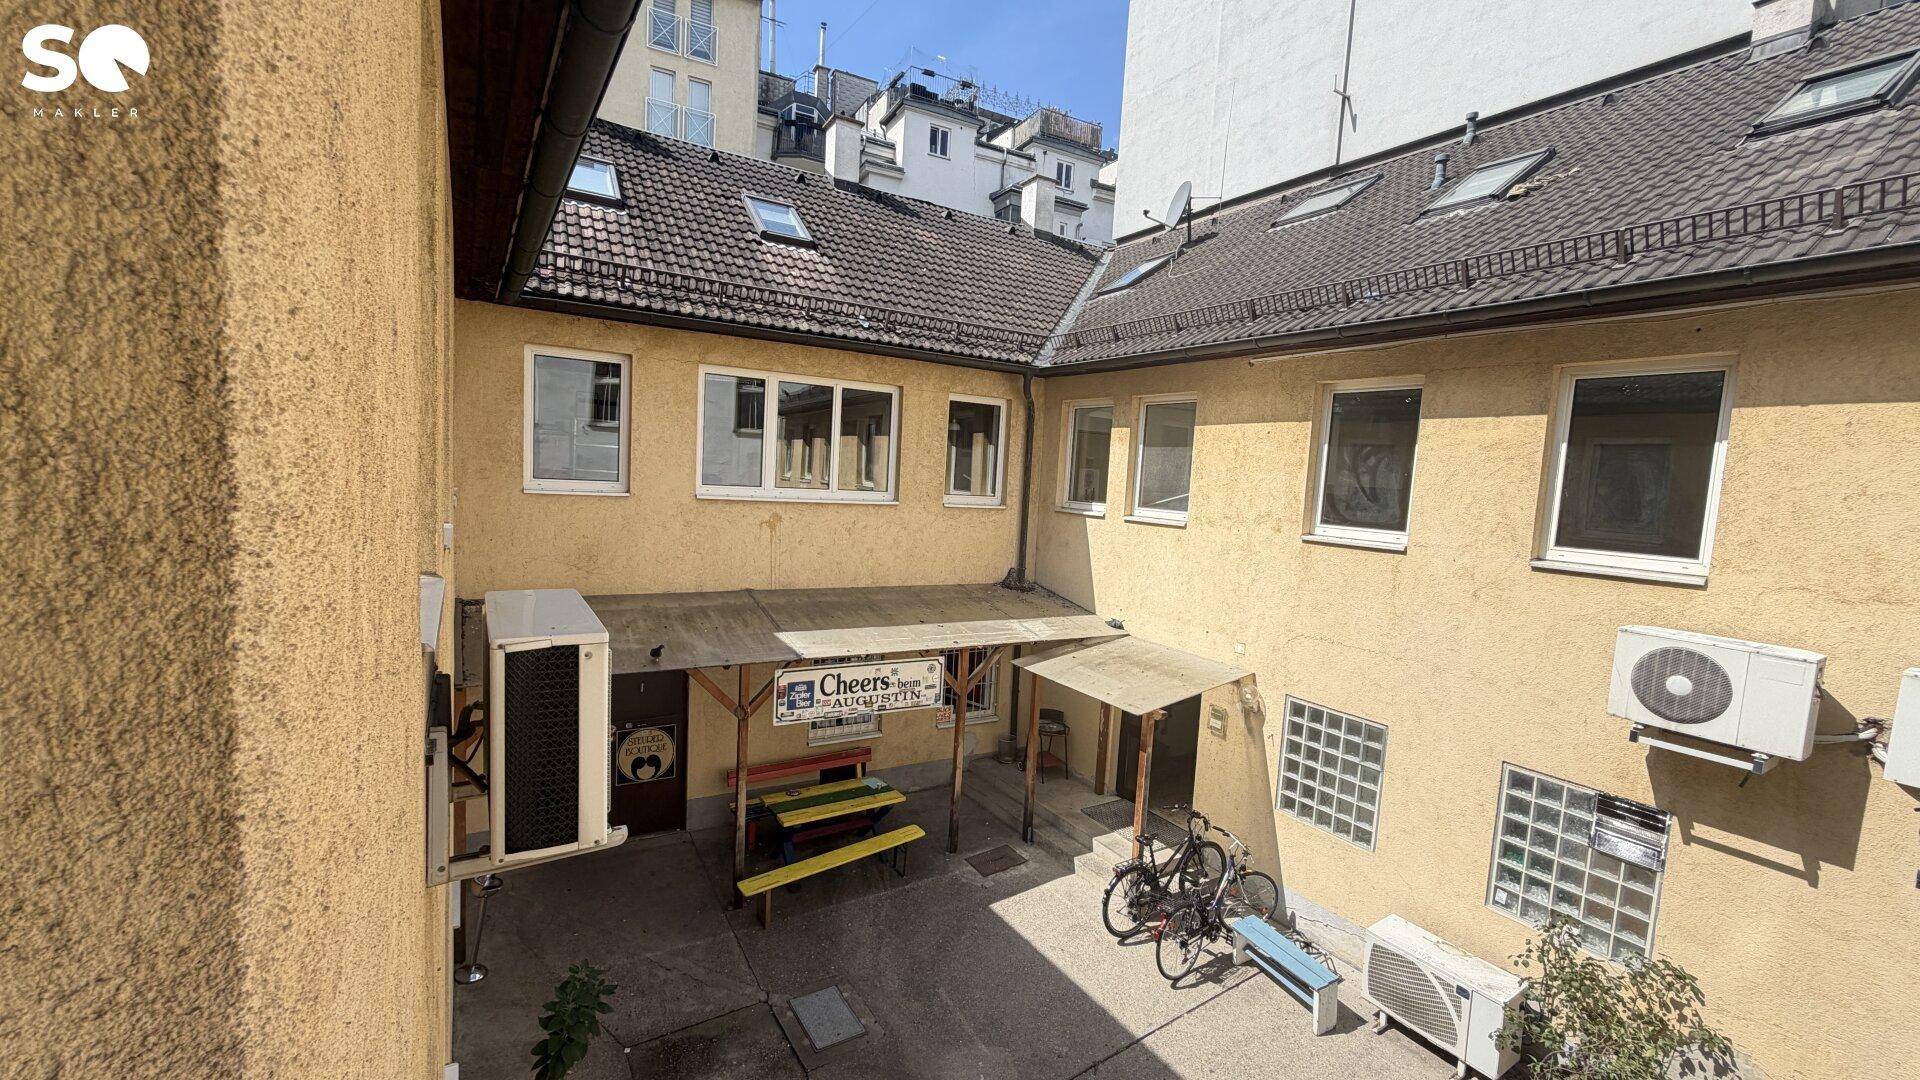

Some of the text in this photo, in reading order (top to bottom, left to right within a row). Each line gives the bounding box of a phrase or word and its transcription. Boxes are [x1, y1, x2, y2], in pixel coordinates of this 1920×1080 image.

[820, 672, 921, 697] Cheers beim
[790, 691, 812, 701] Zipfer
[831, 690, 922, 708] AUGUSTIN
[796, 699, 812, 708] Bier
